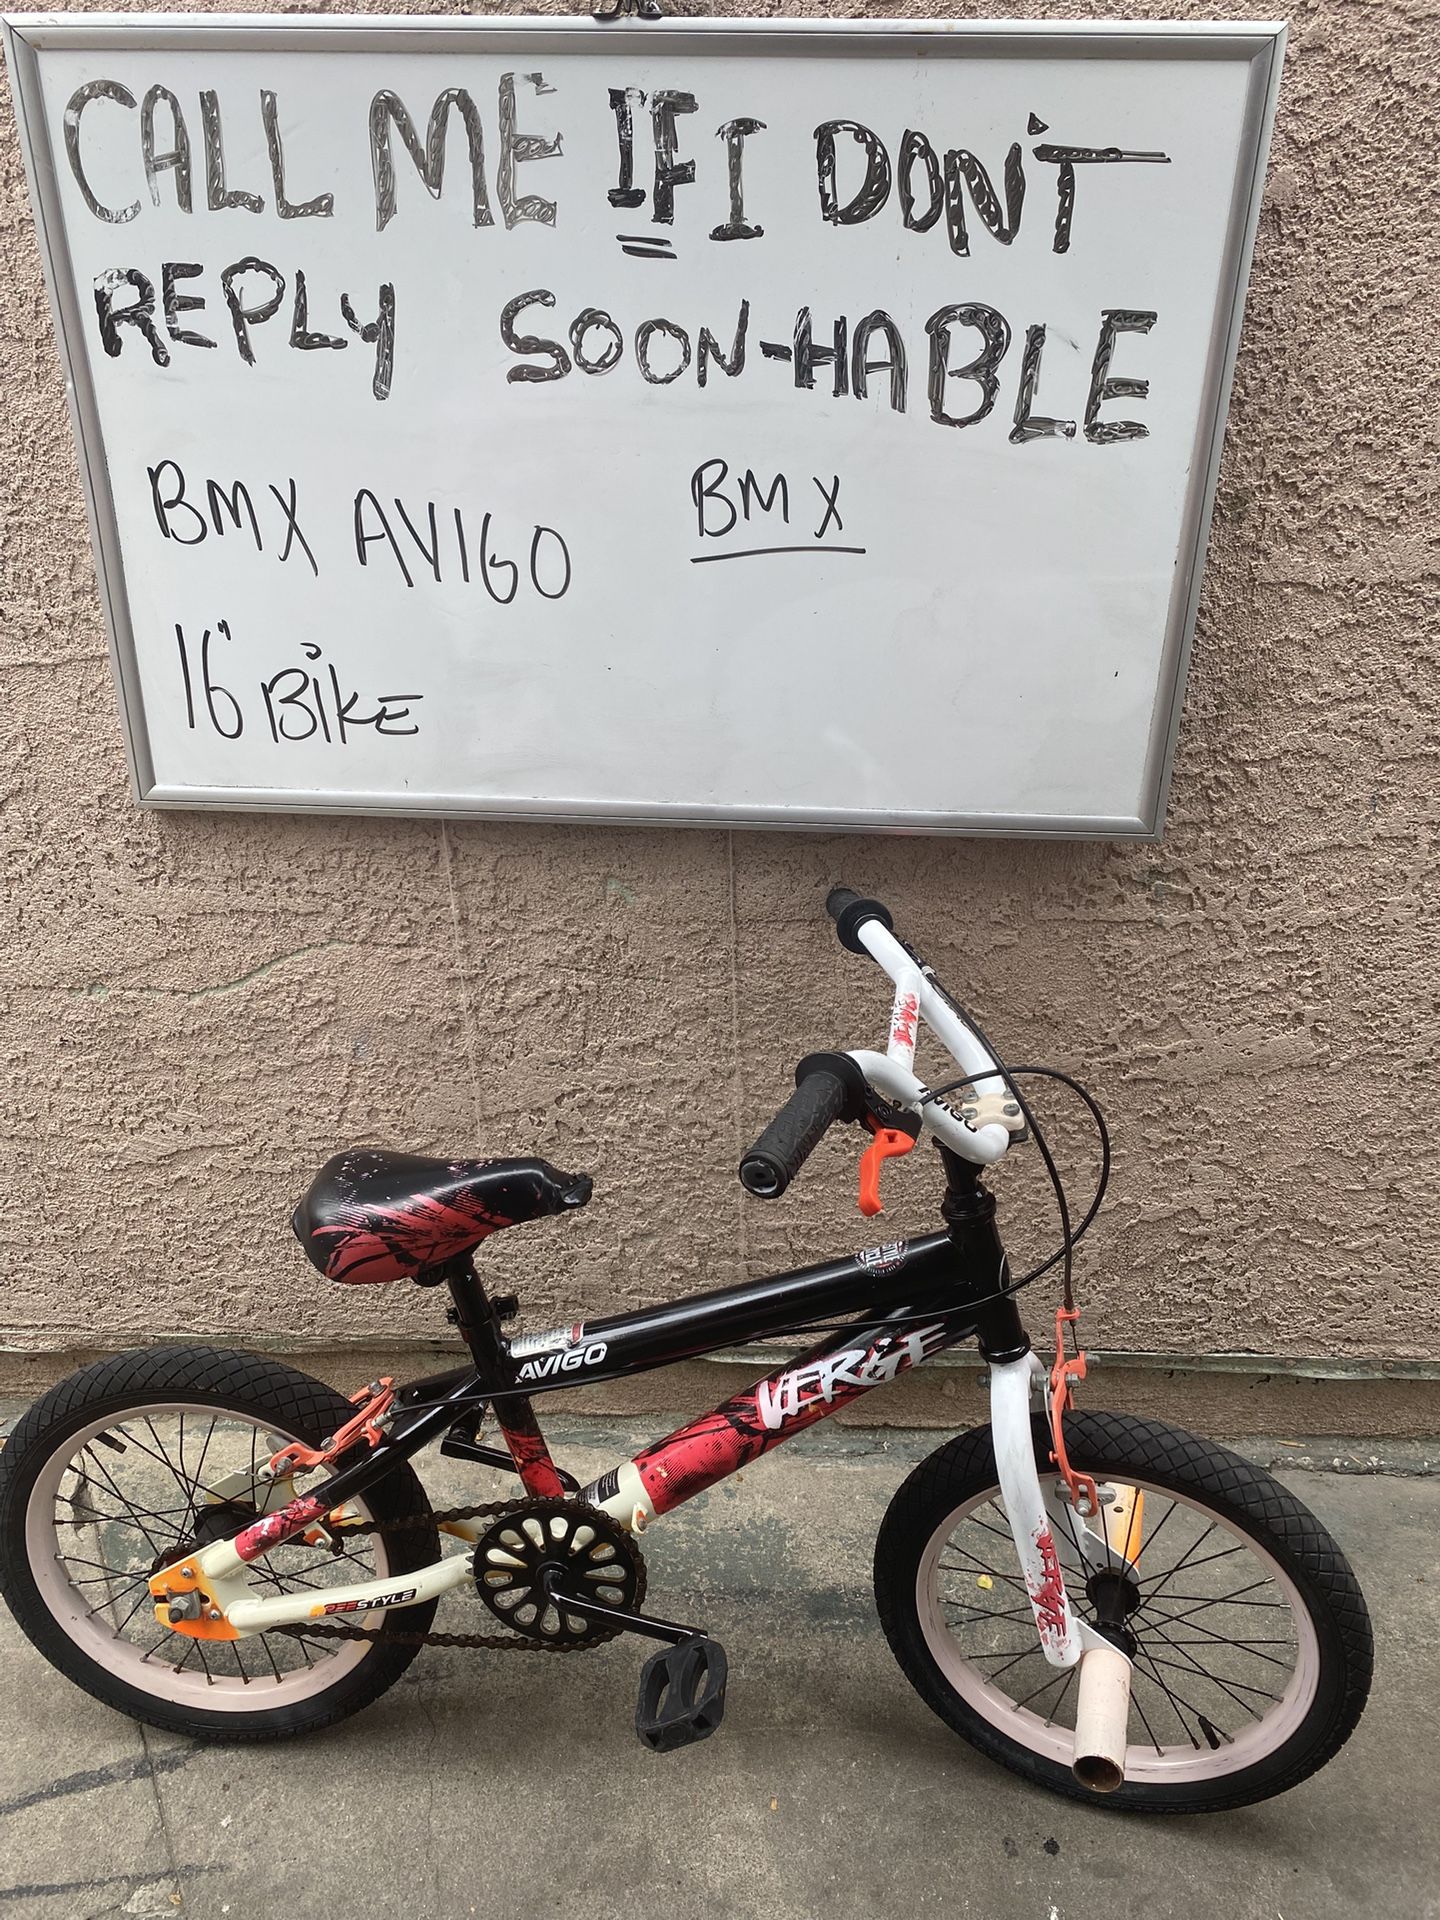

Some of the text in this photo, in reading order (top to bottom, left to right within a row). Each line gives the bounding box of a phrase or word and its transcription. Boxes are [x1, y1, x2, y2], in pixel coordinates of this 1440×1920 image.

[62, 71, 1172, 257] CALL ME IF I DON'T
[92, 256, 395, 402] REPLY
[147, 460, 571, 604] BMX AVIGO
[690, 459, 844, 540] BMX
[175, 619, 244, 739] 16"
[514, 1342, 608, 1384] AVIGO
